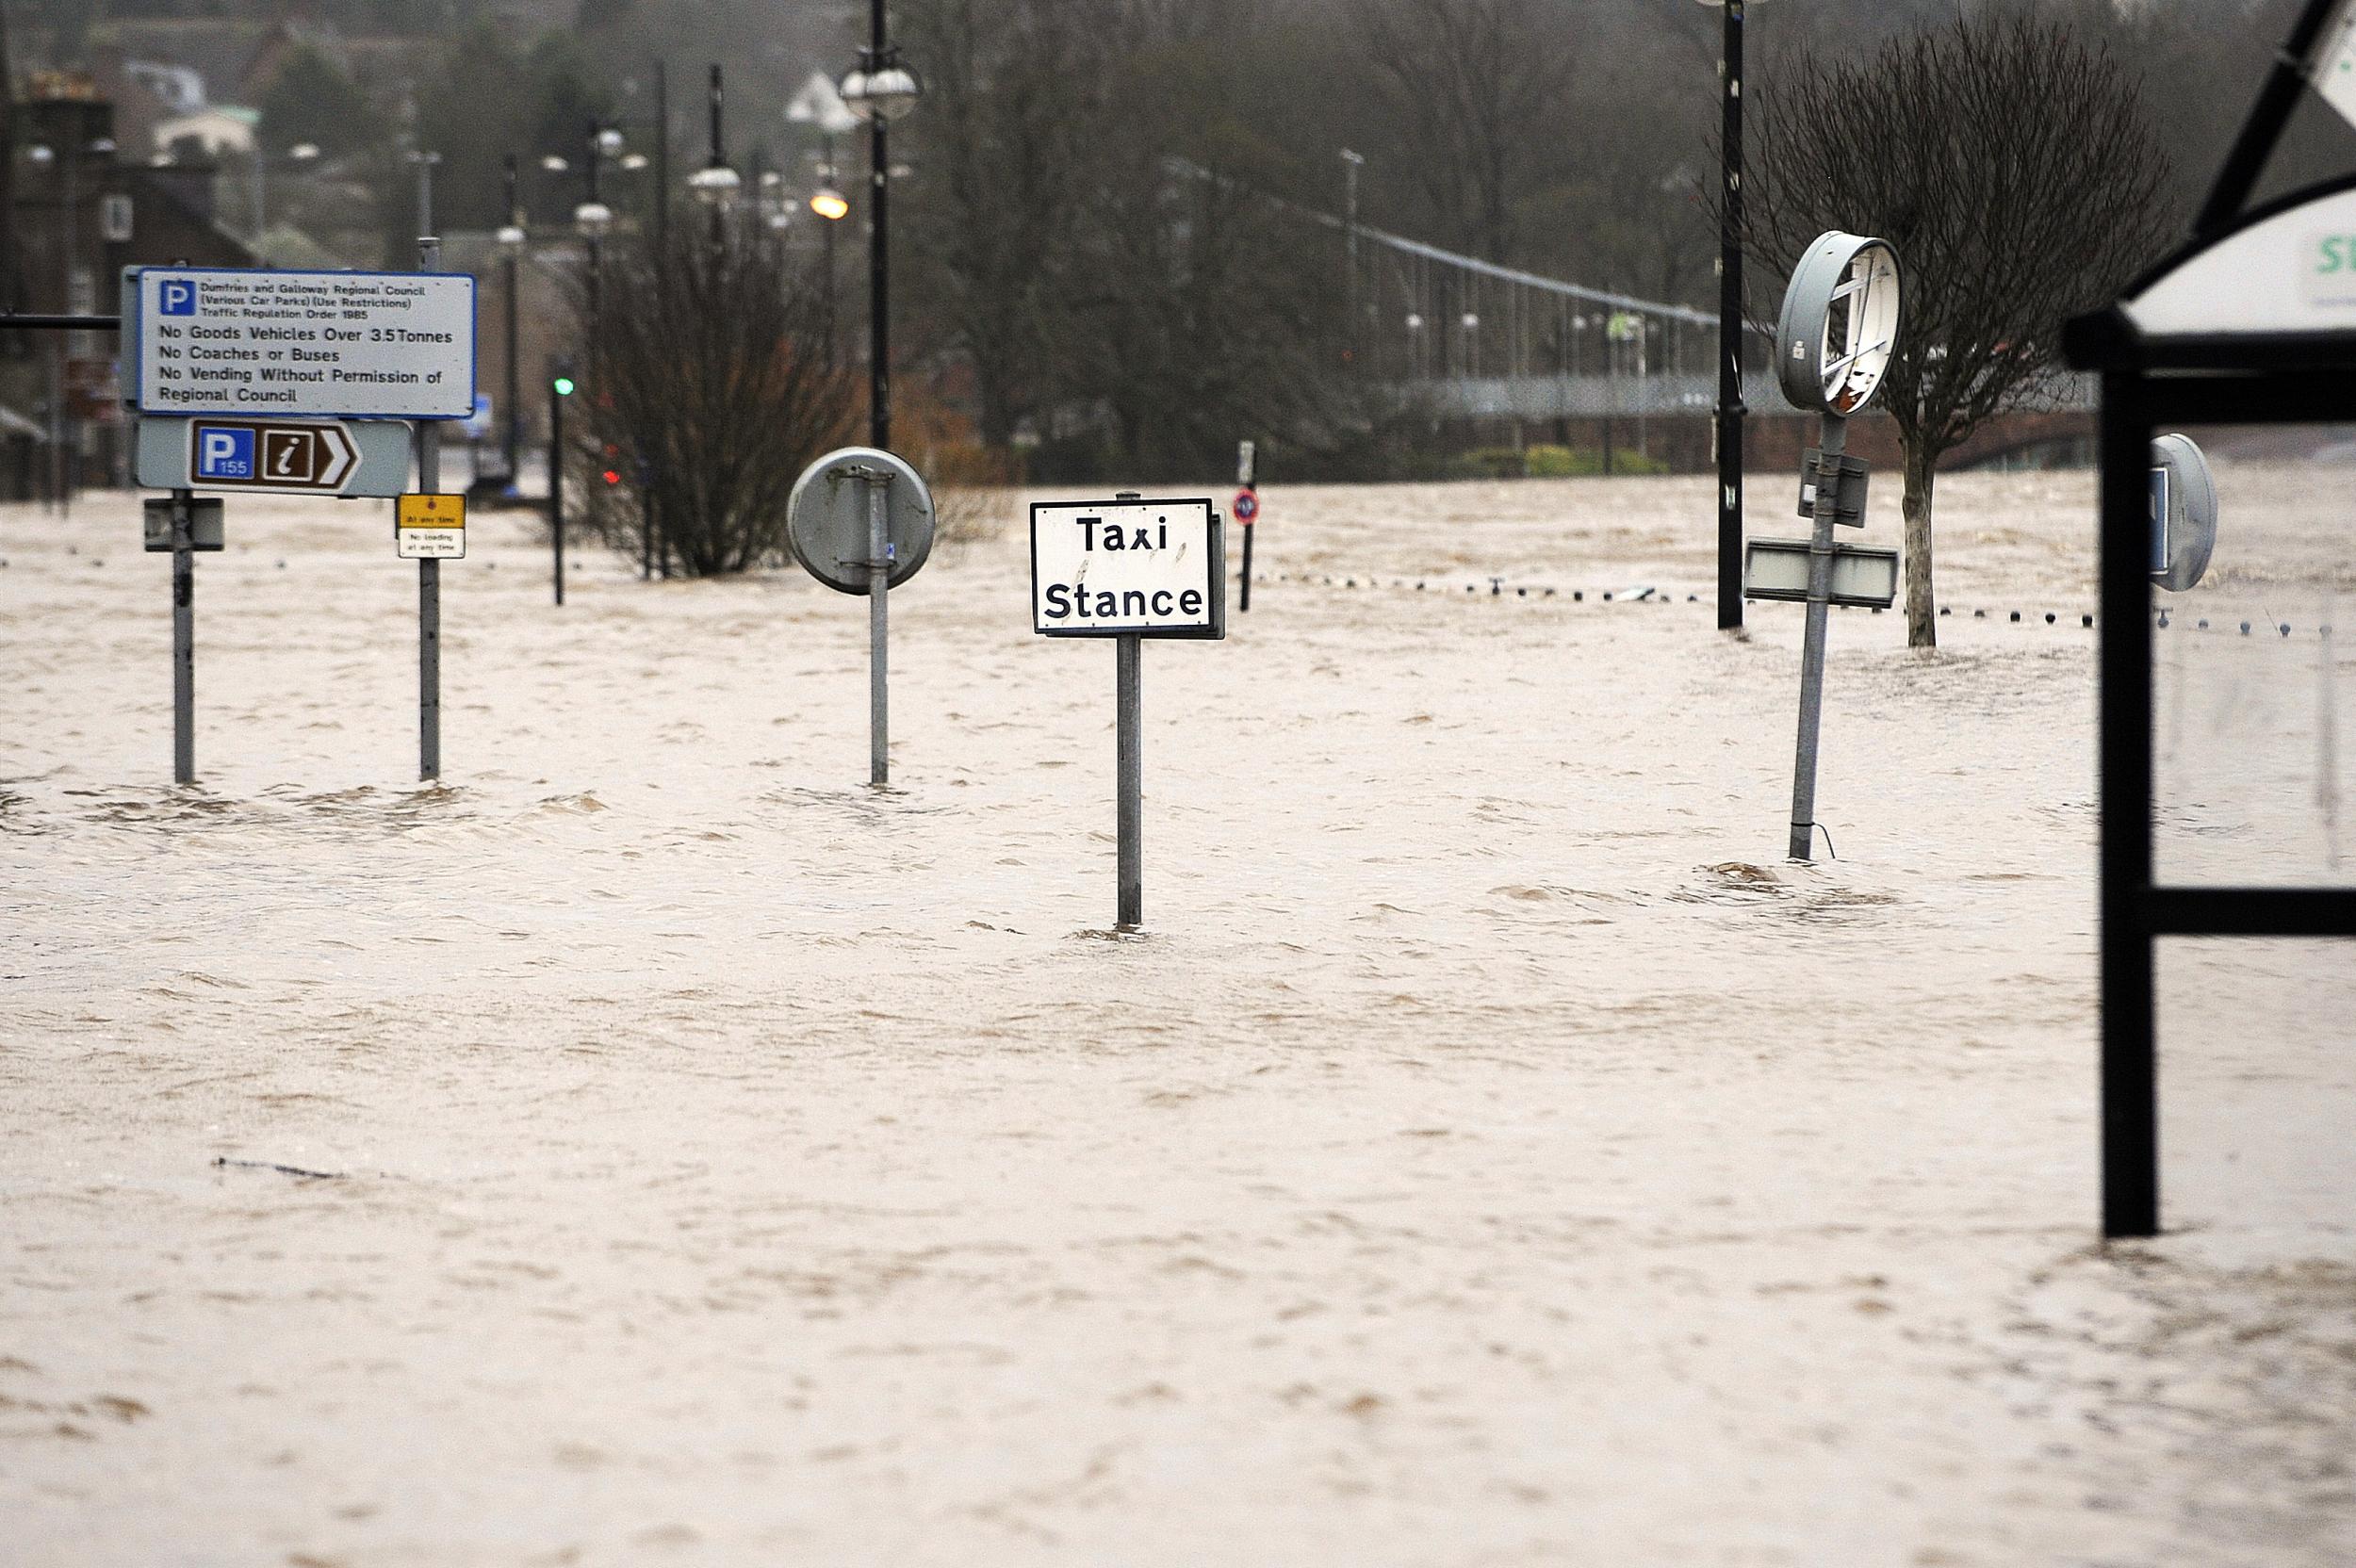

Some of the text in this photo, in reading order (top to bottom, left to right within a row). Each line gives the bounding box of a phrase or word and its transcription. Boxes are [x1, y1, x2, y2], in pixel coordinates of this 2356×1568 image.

[201, 283, 425, 296] Dumfries and Galloway Regional Council
[166, 286, 188, 312] P
[201, 295, 412, 310] (Various Car Parks) (Use Restrictions)
[201, 307, 368, 319] Traffic Regulation Order 1985
[159, 325, 182, 338] No
[190, 326, 241, 340] Goods
[249, 327, 316, 341] Vehicles
[324, 328, 363, 341] Over
[159, 346, 340, 362] No Coaches or Buses
[159, 367, 442, 384] No Vending Without Permission of
[159, 387, 297, 402] Regional Council
[205, 433, 236, 473] P
[221, 461, 248, 474] 155
[1076, 515, 1167, 551] Taxi
[1044, 582, 1203, 619] Stance
